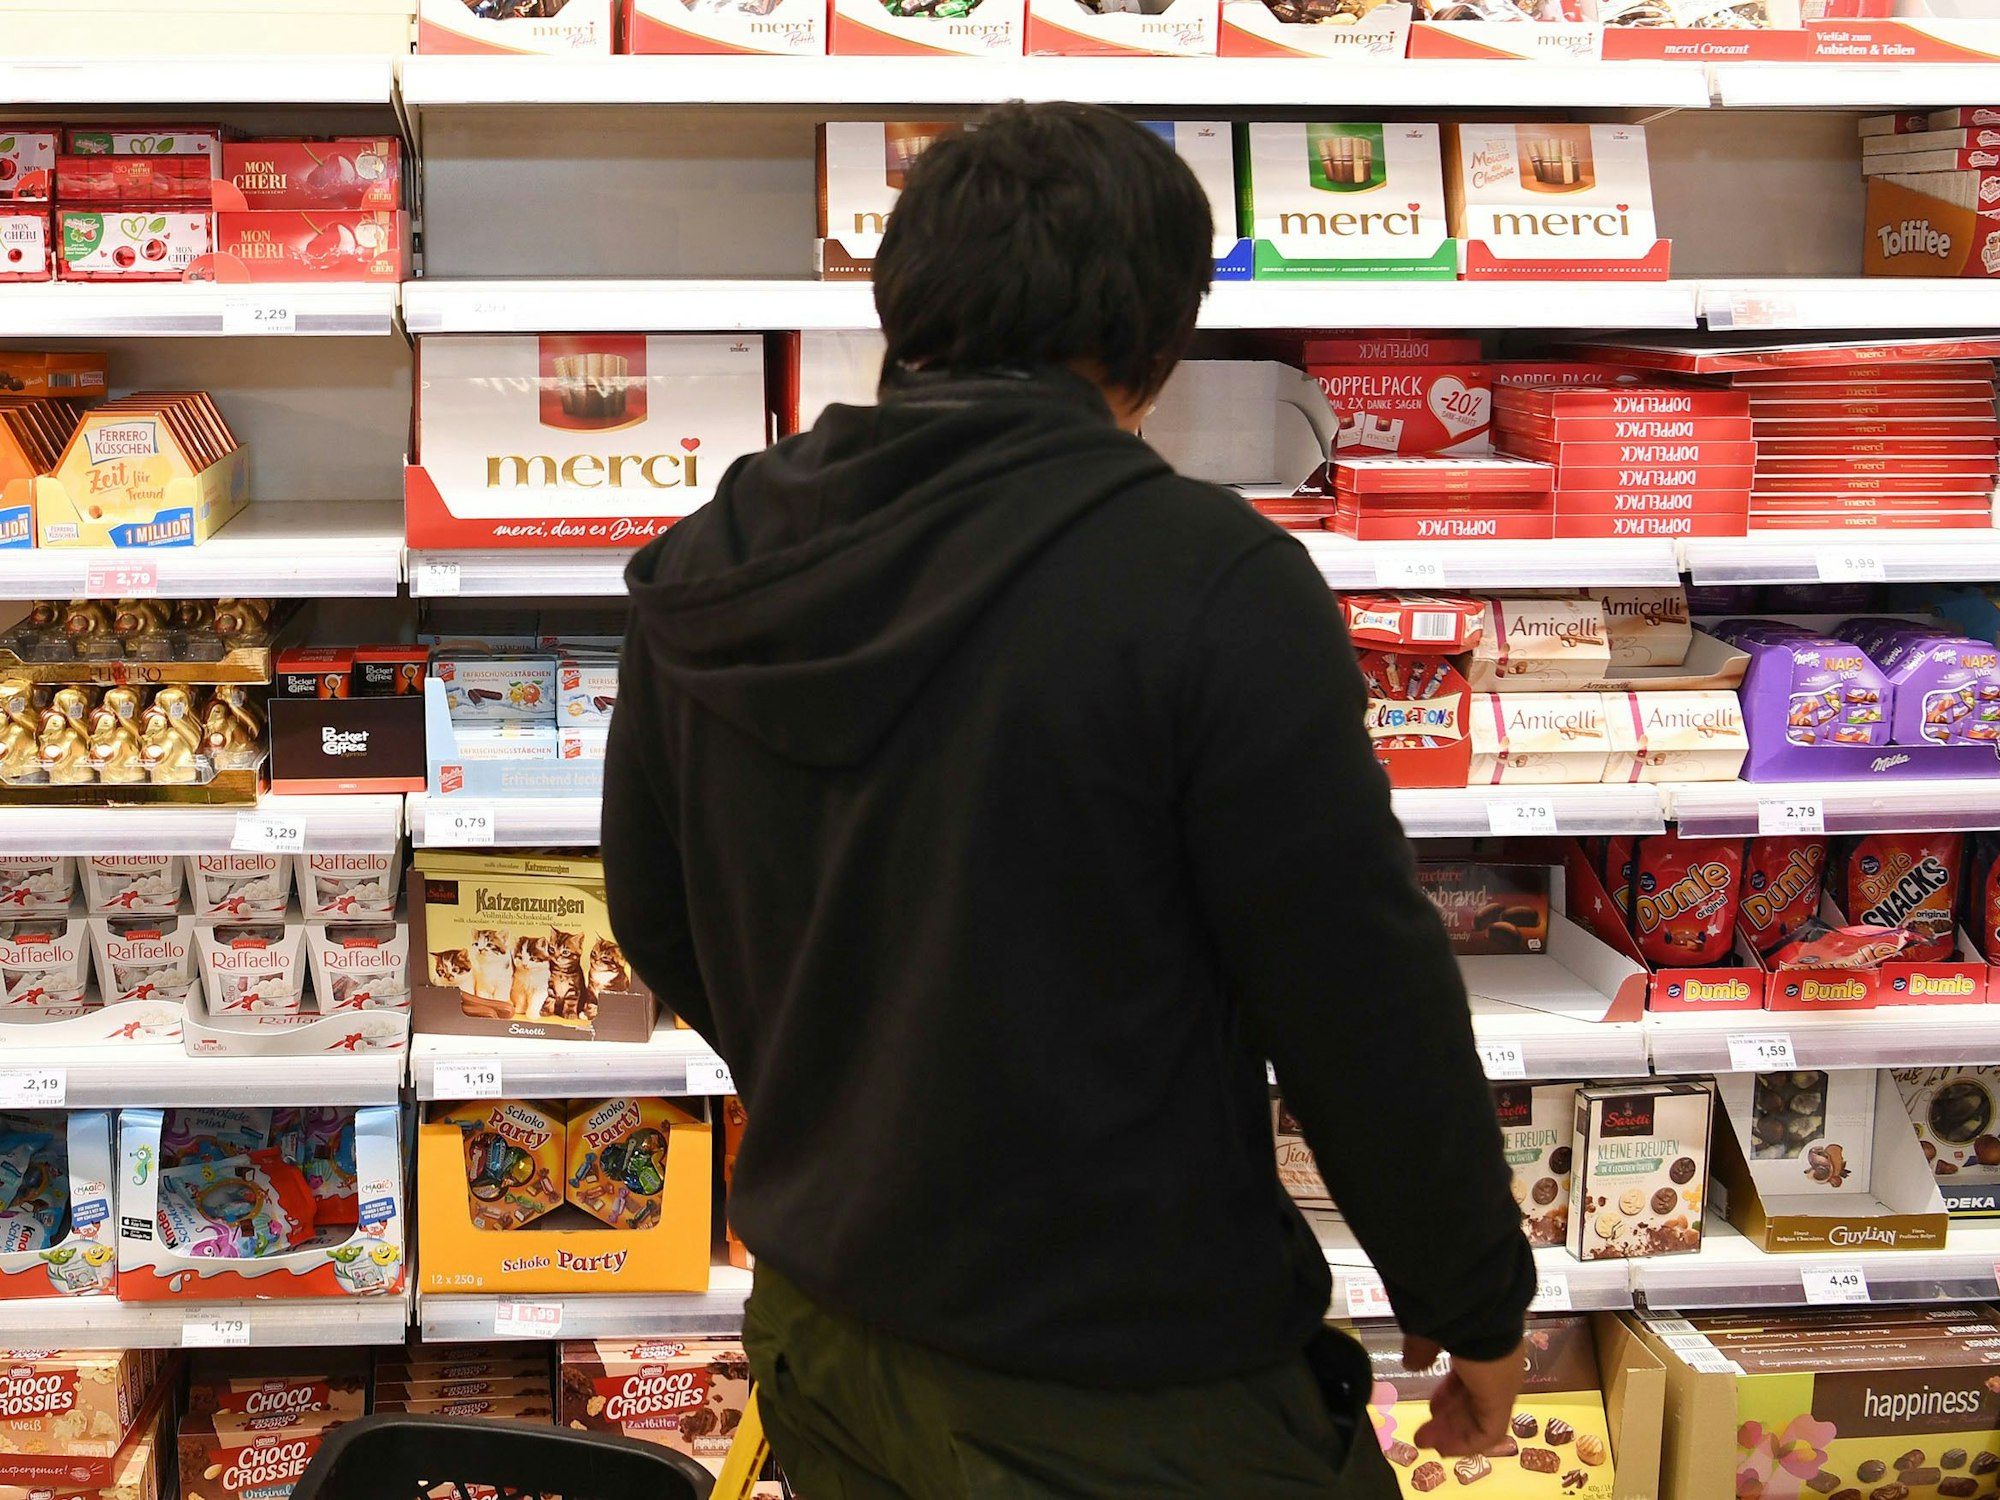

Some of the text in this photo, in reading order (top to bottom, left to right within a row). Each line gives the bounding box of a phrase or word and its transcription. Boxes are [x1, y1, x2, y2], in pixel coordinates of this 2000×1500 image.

[533, 20, 596, 37] merci
[751, 19, 815, 34] merci
[949, 21, 1011, 37] merci
[1141, 18, 1204, 34] merci
[1334, 30, 1397, 46] merci
[1537, 31, 1595, 47] merci
[1817, 31, 1872, 42] Vielfalt zum
[1665, 42, 1750, 55] merci Crocant
[1816, 43, 1916, 56] Anbieten & Teilen
[245, 161, 275, 174] MON
[12, 223, 29, 231] MON
[1279, 202, 1421, 237] merci
[1492, 202, 1630, 237] merci
[240, 230, 272, 242] MON
[1878, 219, 1951, 259] Toffifee
[175, 246, 193, 254] MON
[254, 309, 288, 321] 2,29
[1359, 343, 1429, 359] DOPPELPACK
[1855, 349, 1887, 359] merci
[1318, 375, 1424, 397] DOPPELPACK
[1348, 397, 1422, 410] 2X DANKE SAGEN
[1441, 391, 1483, 417] -20%
[1613, 396, 1691, 413] DOPPELPACK
[99, 428, 148, 442] FERRERO
[1615, 421, 1694, 438] DOPPELPACK
[95, 441, 151, 455] KÜSSCHEN
[1621, 446, 1699, 462] DOPPELPACK
[1852, 442, 1884, 452] merci
[486, 437, 700, 489] merci
[1854, 461, 1885, 471] merci
[86, 461, 129, 494] Zeit
[1619, 470, 1696, 486] DOPPELPACK
[1848, 479, 1880, 489] merci
[1614, 494, 1693, 510] DOPPELPACK
[1844, 498, 1876, 508] merci
[1417, 519, 1497, 536] DOPPELPACK
[1613, 517, 1691, 534] DOPPELPACK
[1844, 516, 1877, 526] merci
[125, 530, 133, 545] 1
[136, 518, 192, 544] MILLION
[493, 521, 548, 538] merci,
[551, 519, 586, 537] dass
[589, 525, 606, 537] es
[610, 518, 655, 541] Dich
[429, 565, 458, 577] 5,79
[1405, 564, 1436, 576] 4,99
[1845, 557, 1876, 570] 9,99
[117, 572, 150, 585] 2,79
[1602, 595, 1681, 616] Amicelli
[1509, 615, 1598, 637] Amicelli
[1793, 650, 1820, 666] Milka
[1824, 656, 1864, 671] NAPS
[1960, 654, 1997, 669] NAPS
[366, 664, 394, 675] Pocket
[366, 673, 392, 682] Coffee
[1840, 671, 1857, 682] Mix
[288, 675, 317, 687] Pocket
[288, 684, 316, 693] Coffee
[1579, 681, 1632, 690] Amicelli
[1509, 709, 1597, 730] Amicelli
[1647, 707, 1733, 729] Amicelli
[322, 726, 370, 744] Pocket
[322, 741, 367, 755] Coffee
[1870, 753, 1911, 773] Milka
[1516, 806, 1546, 819] 2,79
[1786, 806, 1816, 818] 2,79
[455, 817, 486, 830] 0,79
[265, 826, 298, 841] 3,29
[199, 854, 277, 872] Raffaello
[310, 854, 388, 872] Raffaello
[524, 861, 570, 874] Katzenzungen
[1860, 853, 1912, 902] Dumle
[1742, 845, 1824, 930] Dumle
[1862, 857, 1949, 927] SNACKS
[475, 888, 585, 917] Katzenzungen
[1636, 864, 1730, 933] Dumle
[1697, 897, 1728, 919] original
[1916, 910, 1950, 920] original
[482, 912, 554, 922] Vollmilch-Schokolade
[107, 942, 184, 960] Raffaello
[212, 951, 290, 970] Raffaello
[323, 950, 401, 969] Raffaello
[1685, 980, 1749, 1000] Dumle
[1802, 980, 1865, 1000] Dumle
[1910, 974, 1975, 995] Dumle
[508, 1024, 546, 1037] Sarotti
[1487, 1050, 1515, 1062] 1,19
[1756, 1045, 1787, 1059] 1,59
[463, 1072, 495, 1085] 1,19
[505, 1105, 545, 1129] Schoko
[588, 1100, 626, 1130] Schoko
[1604, 1112, 1651, 1128] Sarotti
[488, 1109, 550, 1149] Party
[585, 1101, 641, 1149] Party
[1515, 1129, 1558, 1148] FREUDEN
[1598, 1139, 1680, 1160] KLEINE FREUDEN
[78, 1183, 105, 1193] MAGIC
[365, 1180, 392, 1191] MAGIC
[502, 1249, 627, 1274] Schoko Party
[430, 1273, 484, 1287] 12 x 250 g
[1829, 1274, 1859, 1288] 4,49
[522, 1307, 555, 1322] 1,99
[211, 1319, 243, 1333] 1,79
[1946, 1324, 1998, 1334] happiness
[0, 1375, 61, 1399] CHOCO
[622, 1372, 694, 1397] CHOCO
[0, 1391, 73, 1417] ROSSIES
[246, 1386, 311, 1414] CHOCO
[606, 1387, 703, 1420] CROSSIES
[1863, 1384, 1981, 1421] happiness
[10, 1419, 42, 1432] Weiß
[626, 1417, 678, 1429] Zartbitter
[238, 1441, 306, 1470] CHOCO
[246, 1484, 292, 1499] Original
